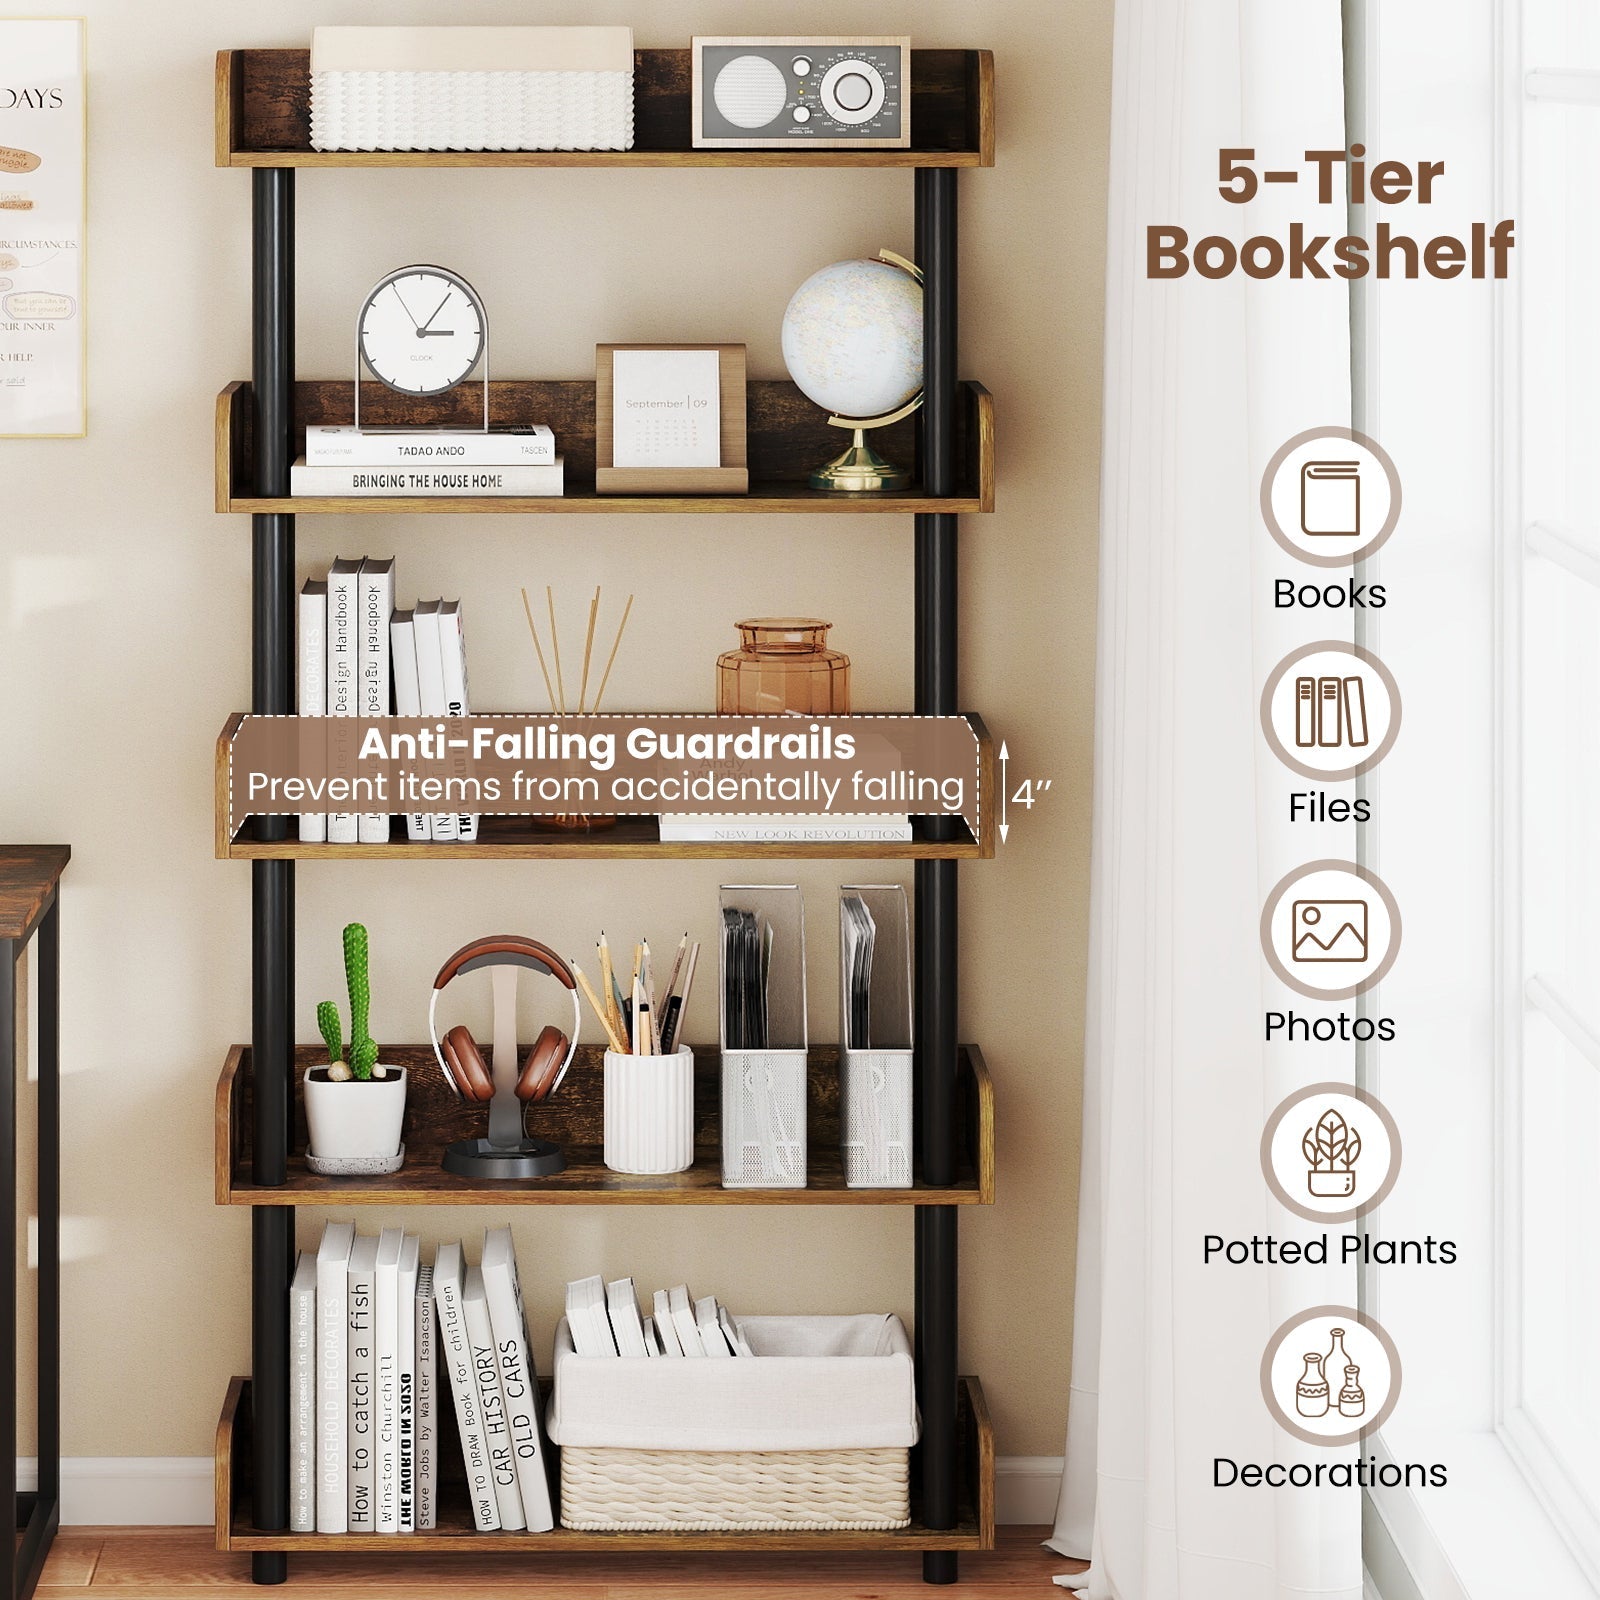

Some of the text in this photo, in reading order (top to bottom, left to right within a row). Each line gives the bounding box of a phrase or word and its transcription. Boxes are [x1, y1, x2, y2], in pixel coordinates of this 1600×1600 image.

[23, 322, 56, 331] INNER
[626, 399, 708, 409] September 09
[397, 446, 465, 456] TADAO ANDO
[521, 446, 548, 455] TASCEN
[353, 475, 502, 488] BRINGING THE HOUSE HOME
[335, 585, 347, 653] Handbook
[306, 628, 320, 711] DECORATES
[335, 661, 350, 712] Design
[714, 829, 905, 841] NEW LOOK REVOLUTION
[443, 1286, 463, 1352] children
[324, 1297, 339, 1493] HOUSEHOLD DECORATES
[456, 1361, 468, 1384] for
[298, 1295, 310, 1525] How to make an arrangement in the house
[351, 1283, 369, 1523] How to catch a fish
[420, 1301, 432, 1526] Steve Jobs by Walter Isaacson
[473, 1346, 514, 1486] CAR HISTORY
[499, 1340, 536, 1459] OLD CARS
[381, 1353, 392, 1522] Winston Churchill
[467, 1434, 483, 1467] DRAW
[474, 1475, 487, 1492] TO
[478, 1500, 493, 1526] HOW
